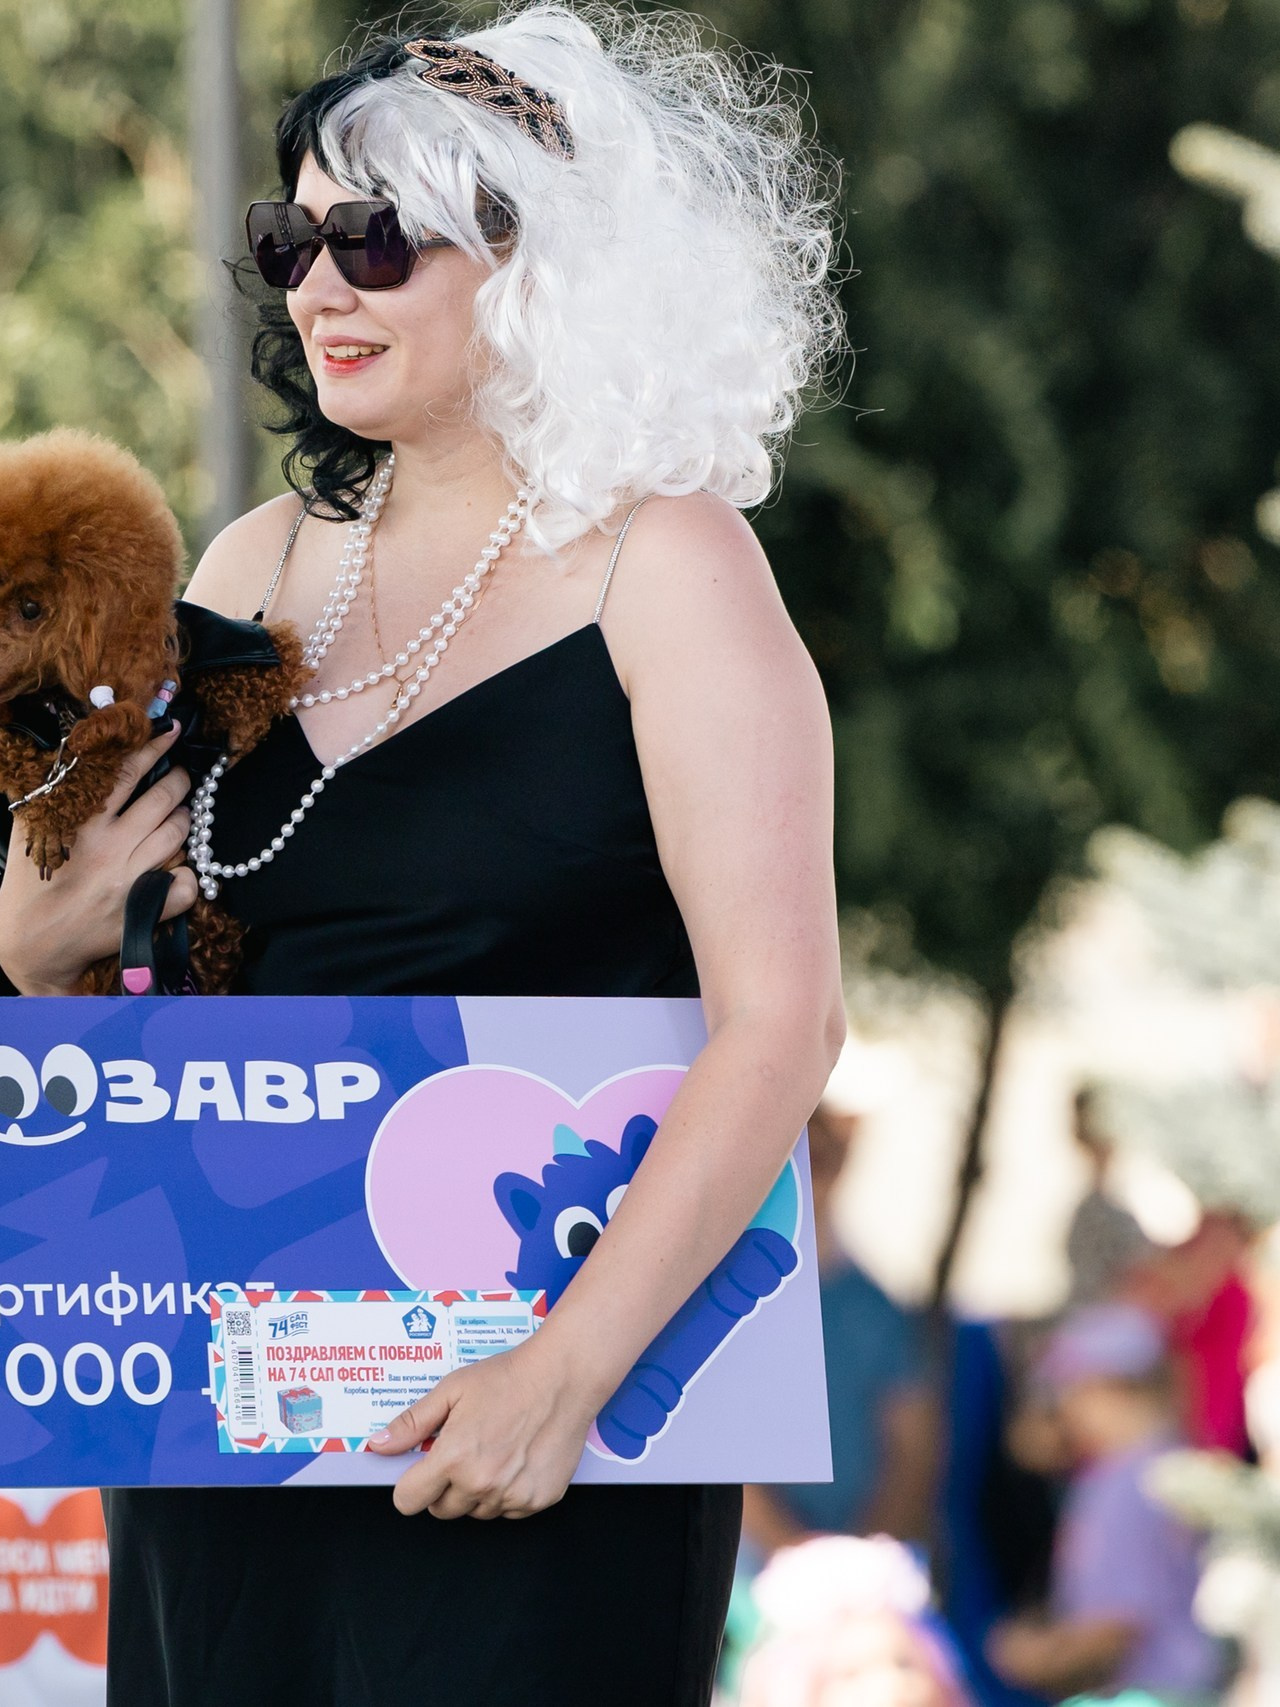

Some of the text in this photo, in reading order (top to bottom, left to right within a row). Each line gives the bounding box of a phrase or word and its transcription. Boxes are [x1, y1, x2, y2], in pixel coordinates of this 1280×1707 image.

[290, 1313, 308, 1321] САП
[268, 1319, 288, 1338] 74
[266, 1342, 443, 1363] ПОЗДРАВЛЯЕМ С ПОБЕДОЙ
[5, 1342, 173, 1407] 000
[268, 1366, 385, 1382] НА 74 САП ФЕСТЕ!
[388, 1374, 401, 1382] Ваш
[402, 1374, 427, 1383] вкусный
[343, 1387, 369, 1395] Коробка
[370, 1387, 408, 1395] фирменного
[379, 1399, 406, 1408] фабрики
